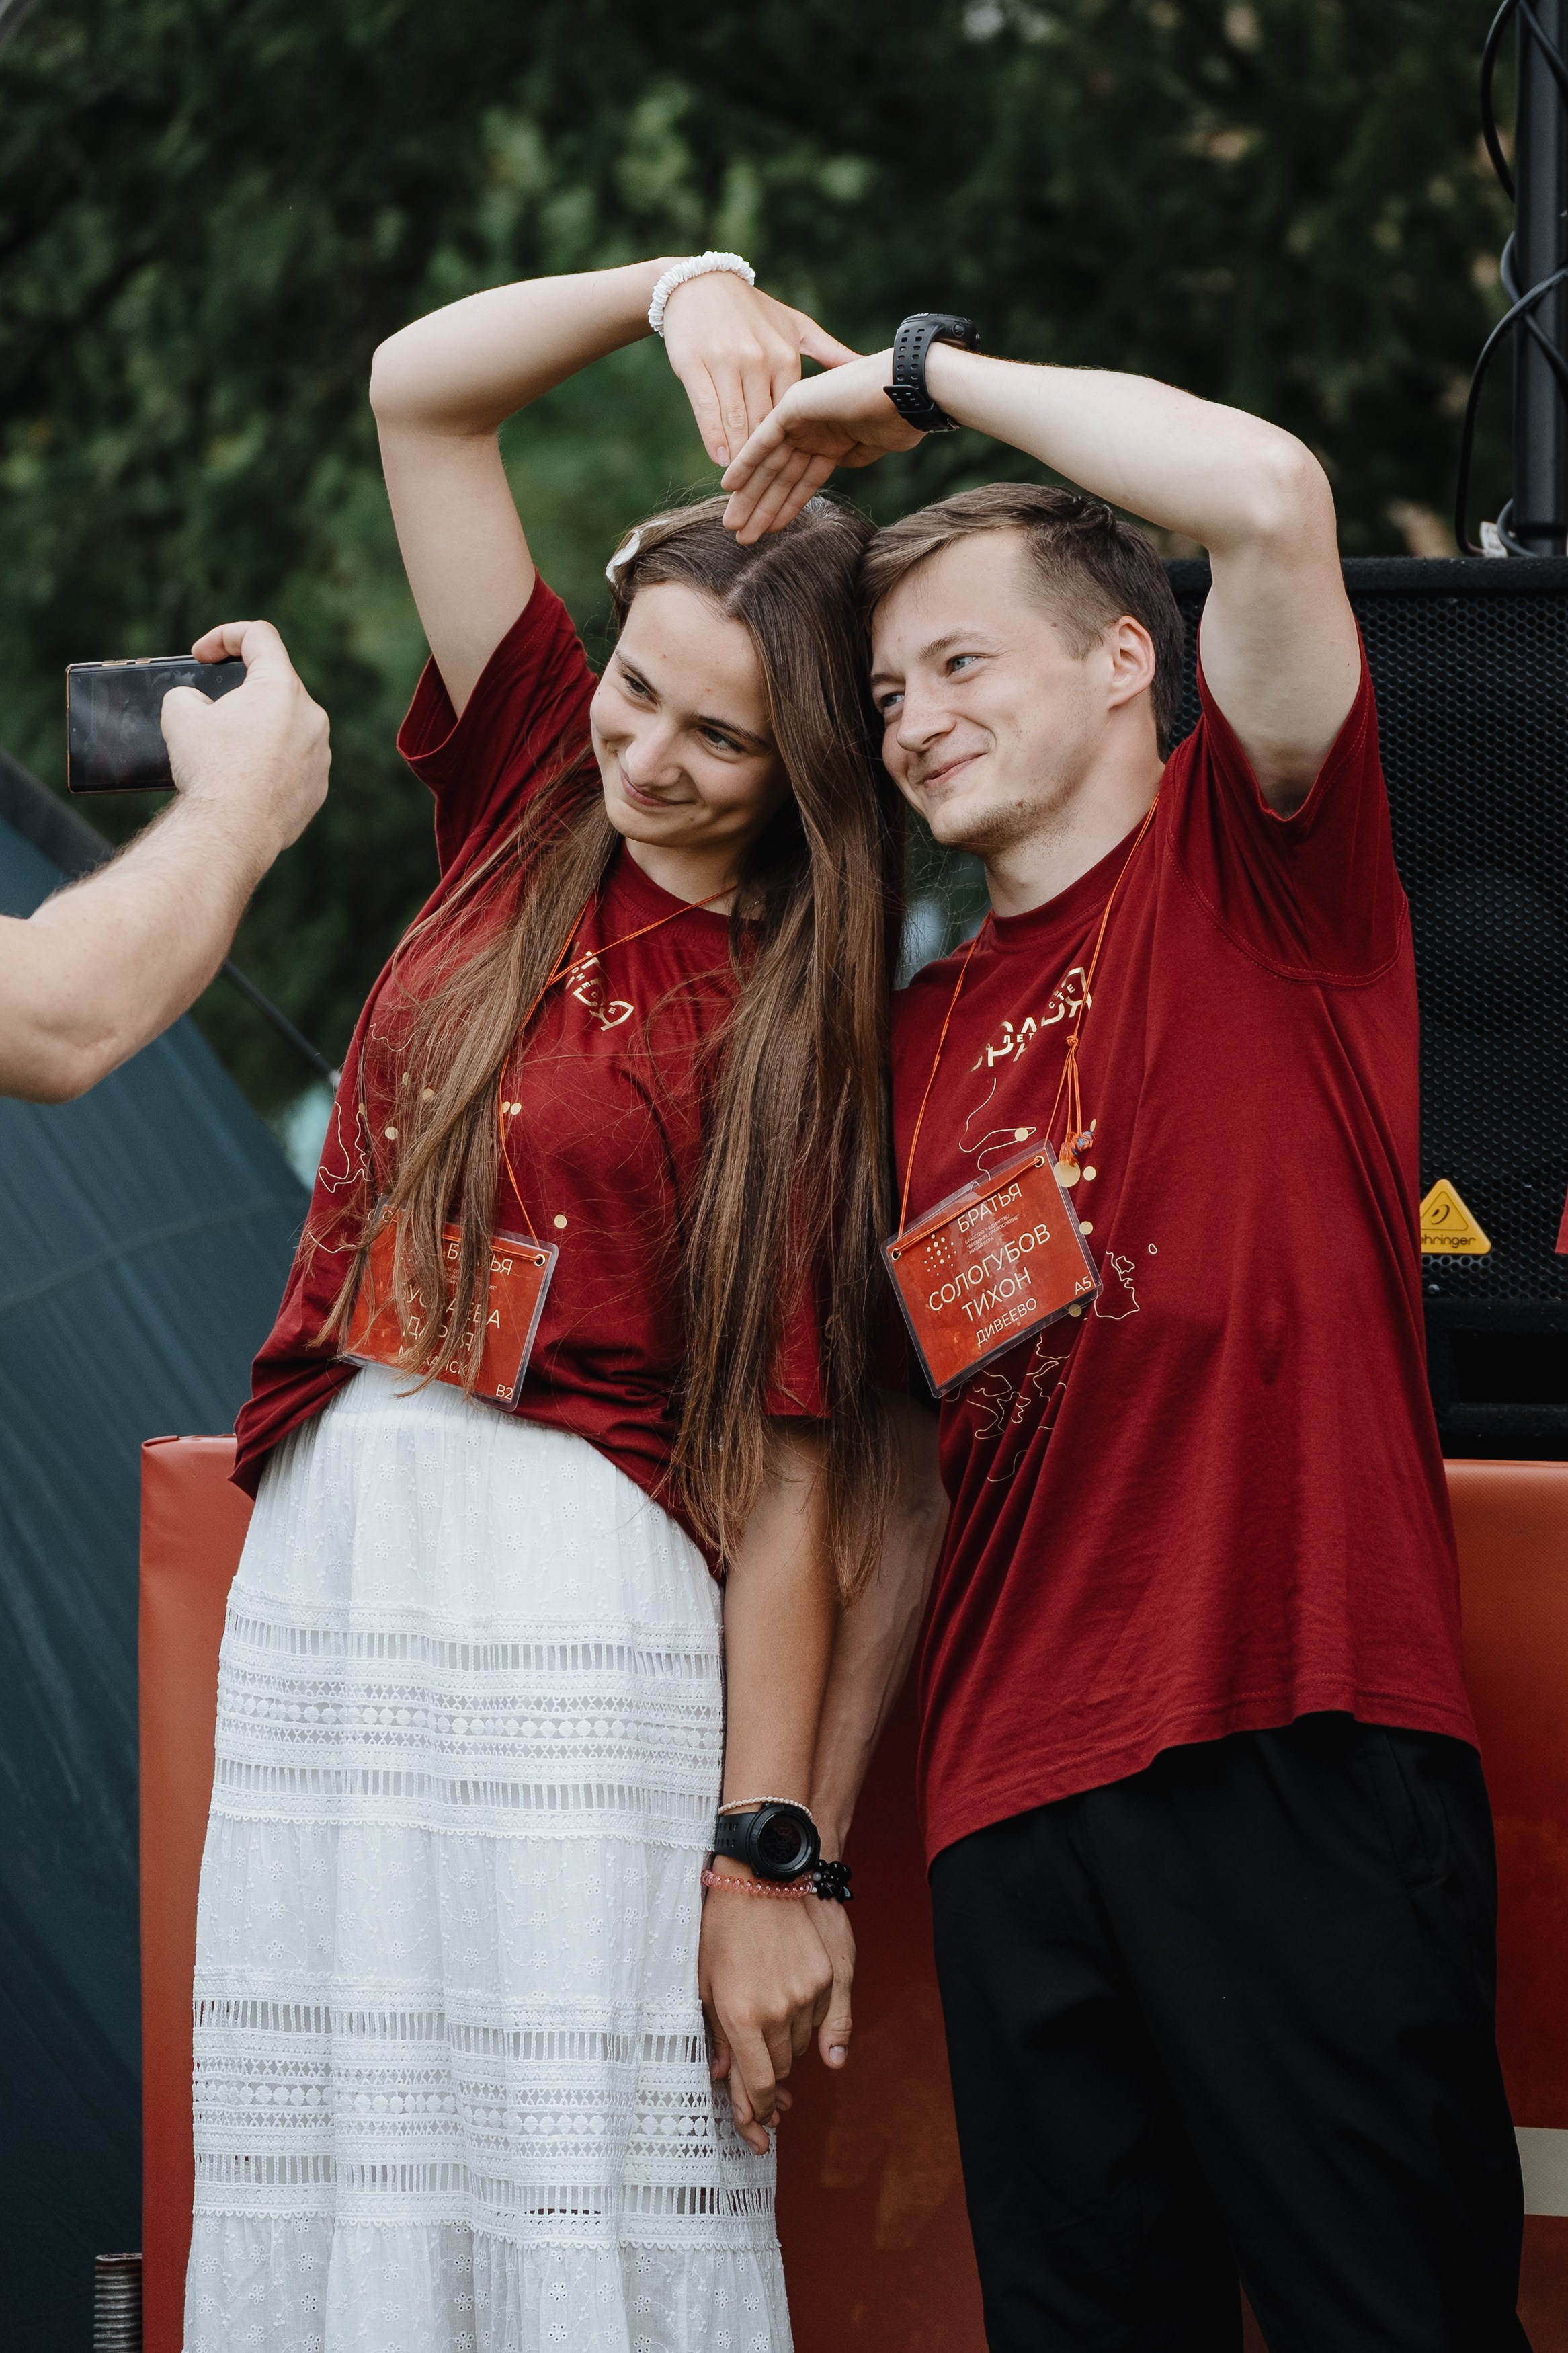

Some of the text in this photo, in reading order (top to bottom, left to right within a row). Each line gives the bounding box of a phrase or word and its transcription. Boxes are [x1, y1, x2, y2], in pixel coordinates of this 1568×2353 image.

[956, 1182, 1022, 1233] БРАТЬЯ
[1421, 1234, 1476, 1248] hringer
[928, 1223, 1051, 1312] СОЛОГУБОВ
[961, 1267, 1032, 1322] ТИХОН
[976, 1298, 1038, 1347] ДИВЕЕВО
